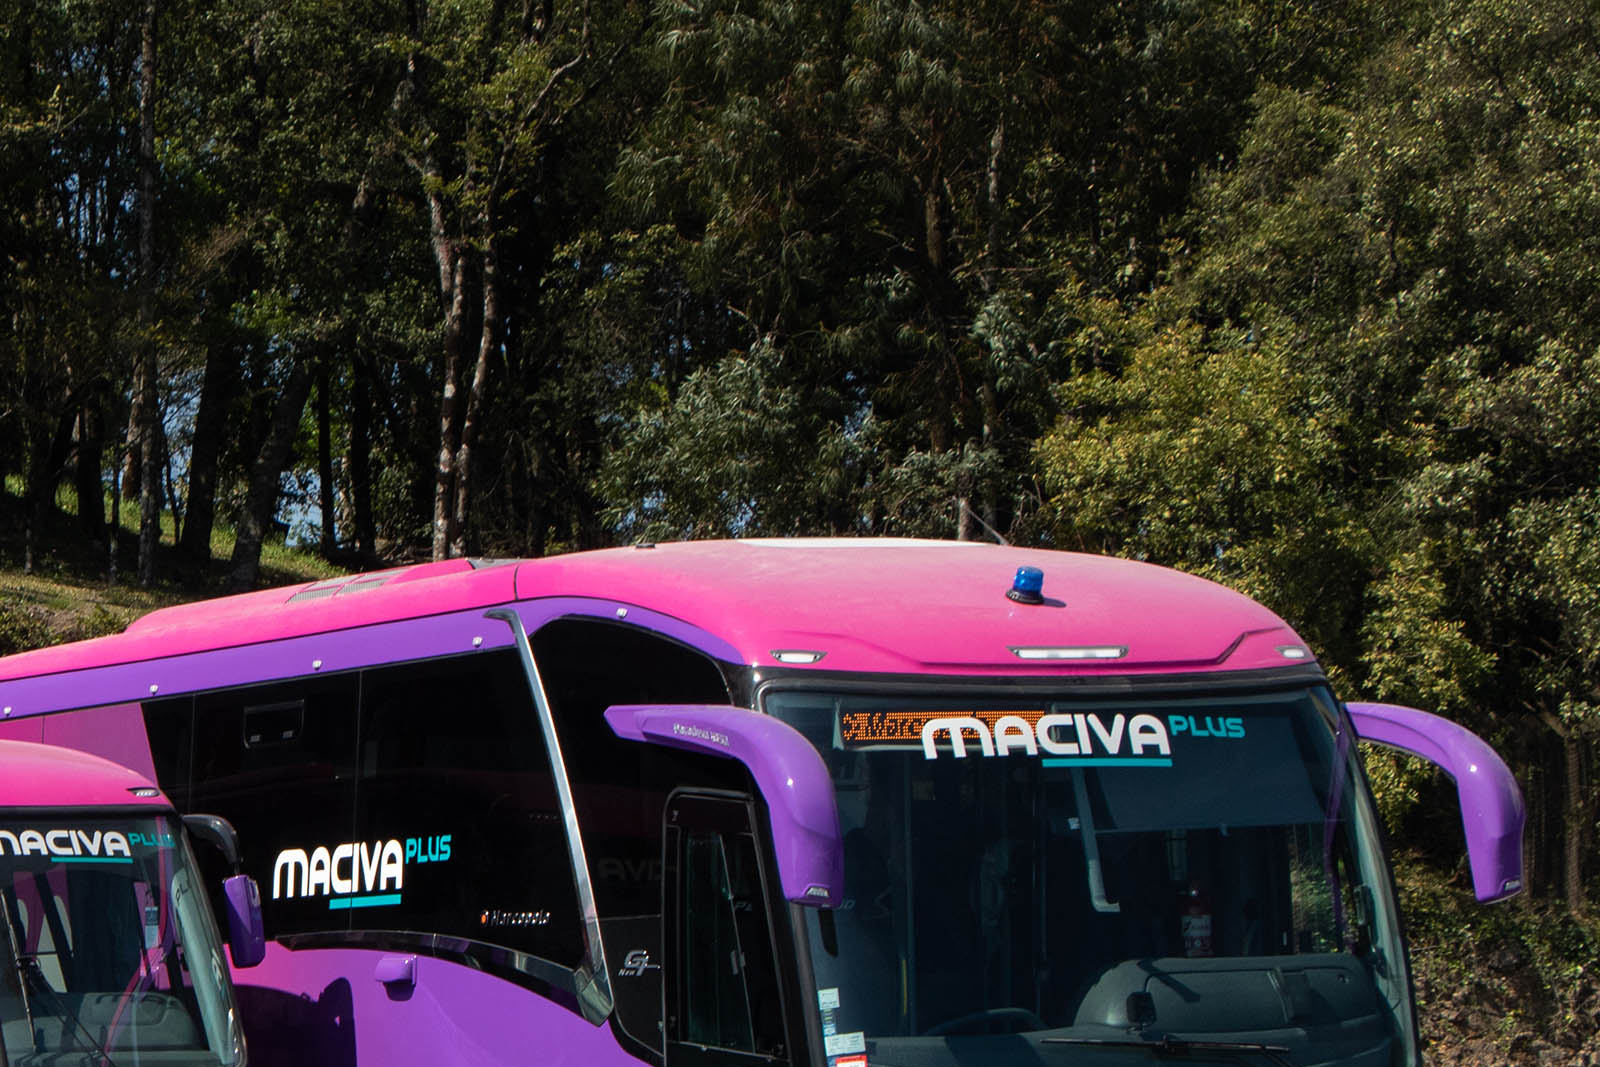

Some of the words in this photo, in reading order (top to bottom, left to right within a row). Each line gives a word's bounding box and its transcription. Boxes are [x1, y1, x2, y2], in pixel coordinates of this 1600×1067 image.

[921, 713, 1172, 760] MACIVA
[1169, 714, 1246, 738] PLUS
[273, 839, 403, 900] MACIVA
[405, 834, 452, 864] PLUS
